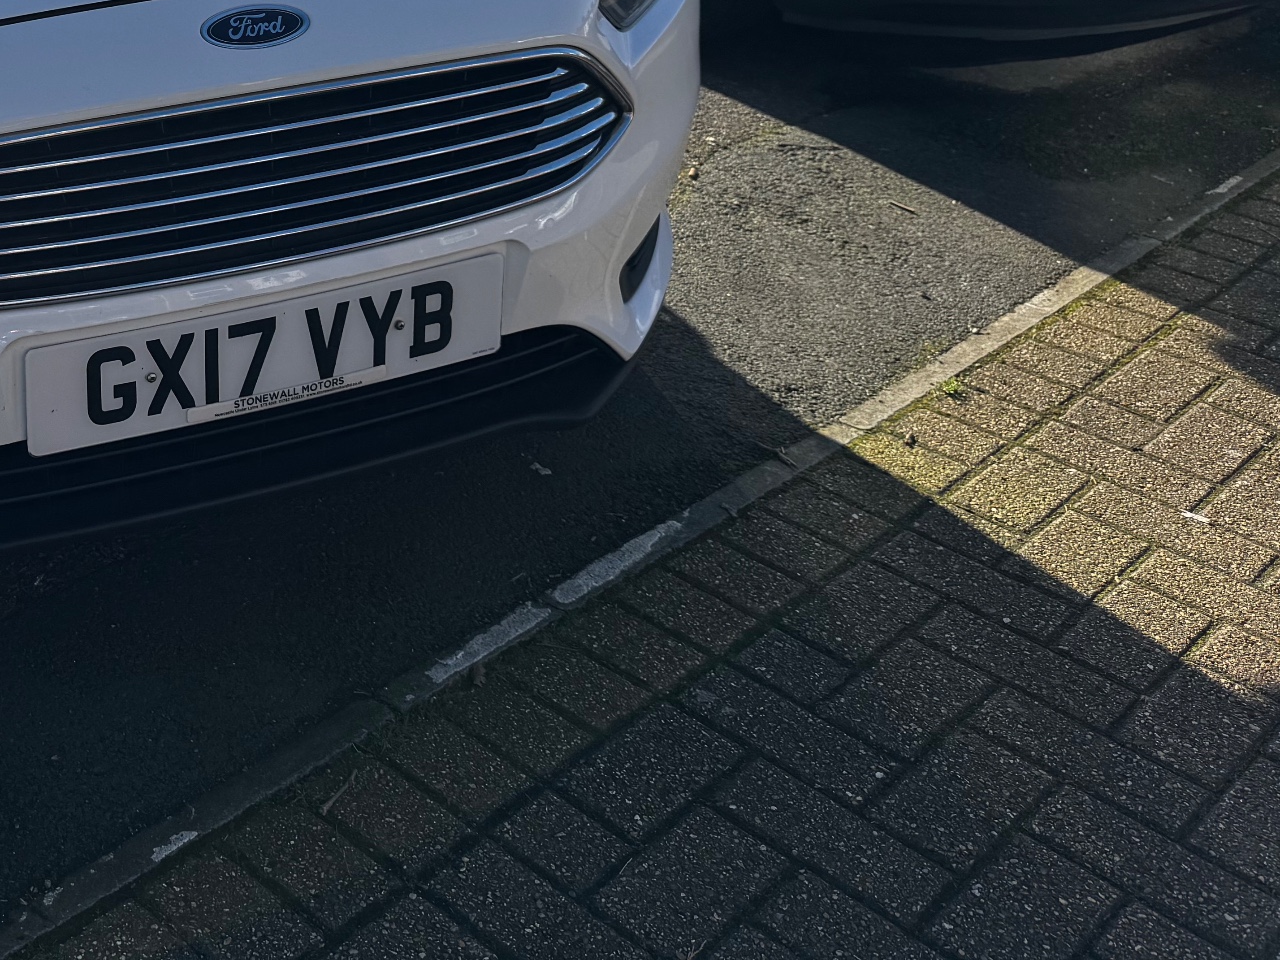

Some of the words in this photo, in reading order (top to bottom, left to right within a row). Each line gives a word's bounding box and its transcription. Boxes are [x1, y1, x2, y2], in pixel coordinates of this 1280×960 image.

[228, 12, 286, 40] Ford
[86, 316, 277, 426] GX17
[304, 280, 454, 380] VYB
[234, 387, 300, 409] STONEWALL
[301, 376, 345, 394] MOTORS
